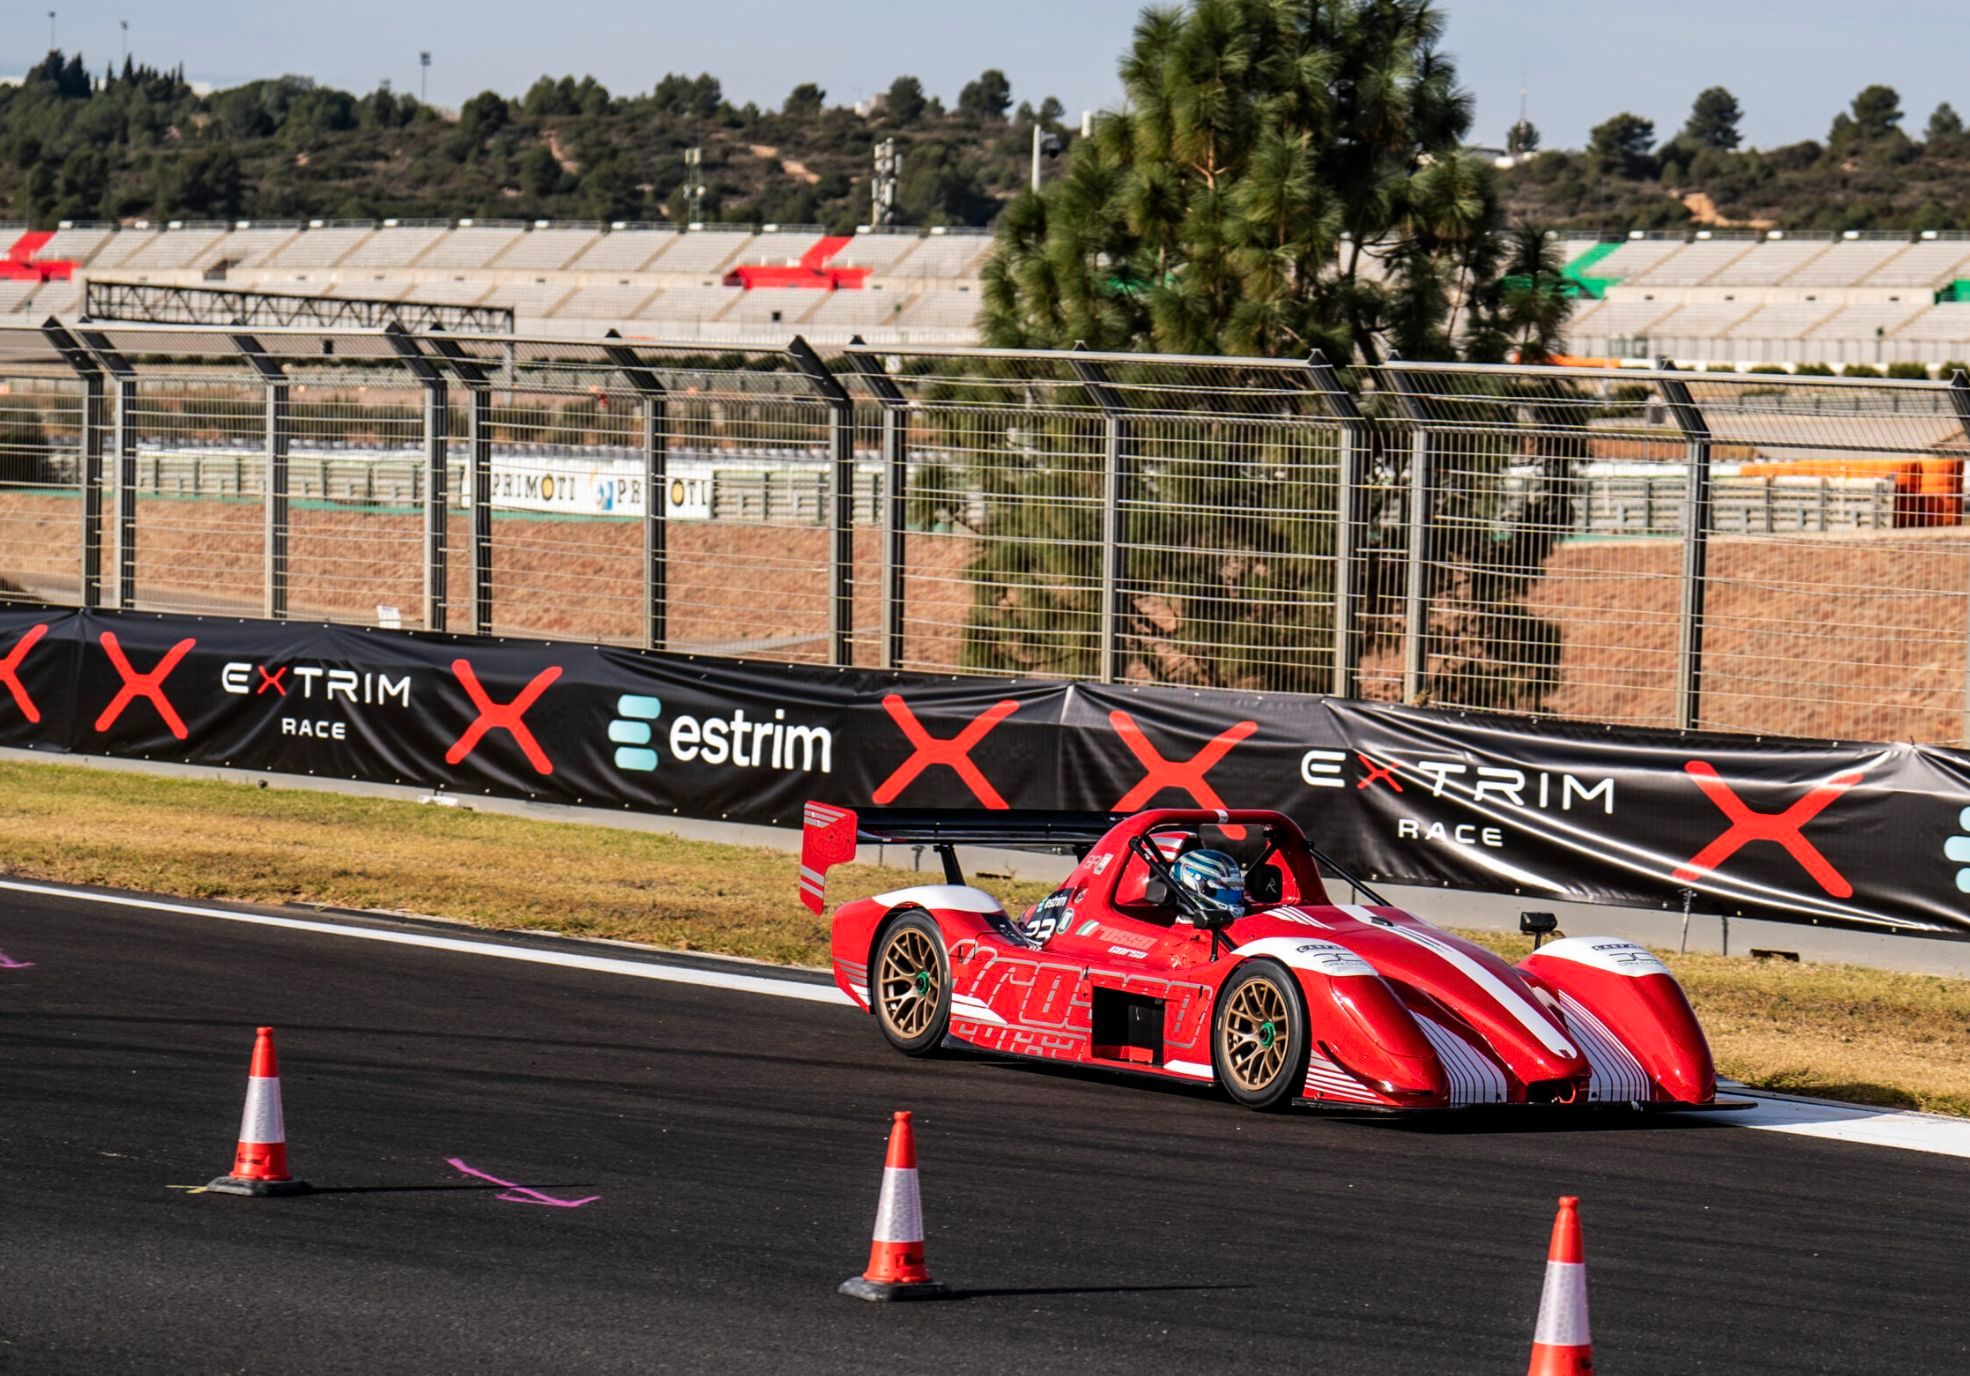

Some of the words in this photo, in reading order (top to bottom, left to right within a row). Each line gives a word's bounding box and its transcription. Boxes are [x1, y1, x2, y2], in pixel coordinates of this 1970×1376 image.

[491, 473, 575, 501] PRIMOTI
[618, 479, 708, 506] PROTI
[221, 662, 412, 707] EXTRIM
[281, 717, 347, 740] RACE
[669, 709, 833, 774] estrim
[1301, 750, 1615, 814] EXTRIM
[1397, 818, 1504, 847] RACE
